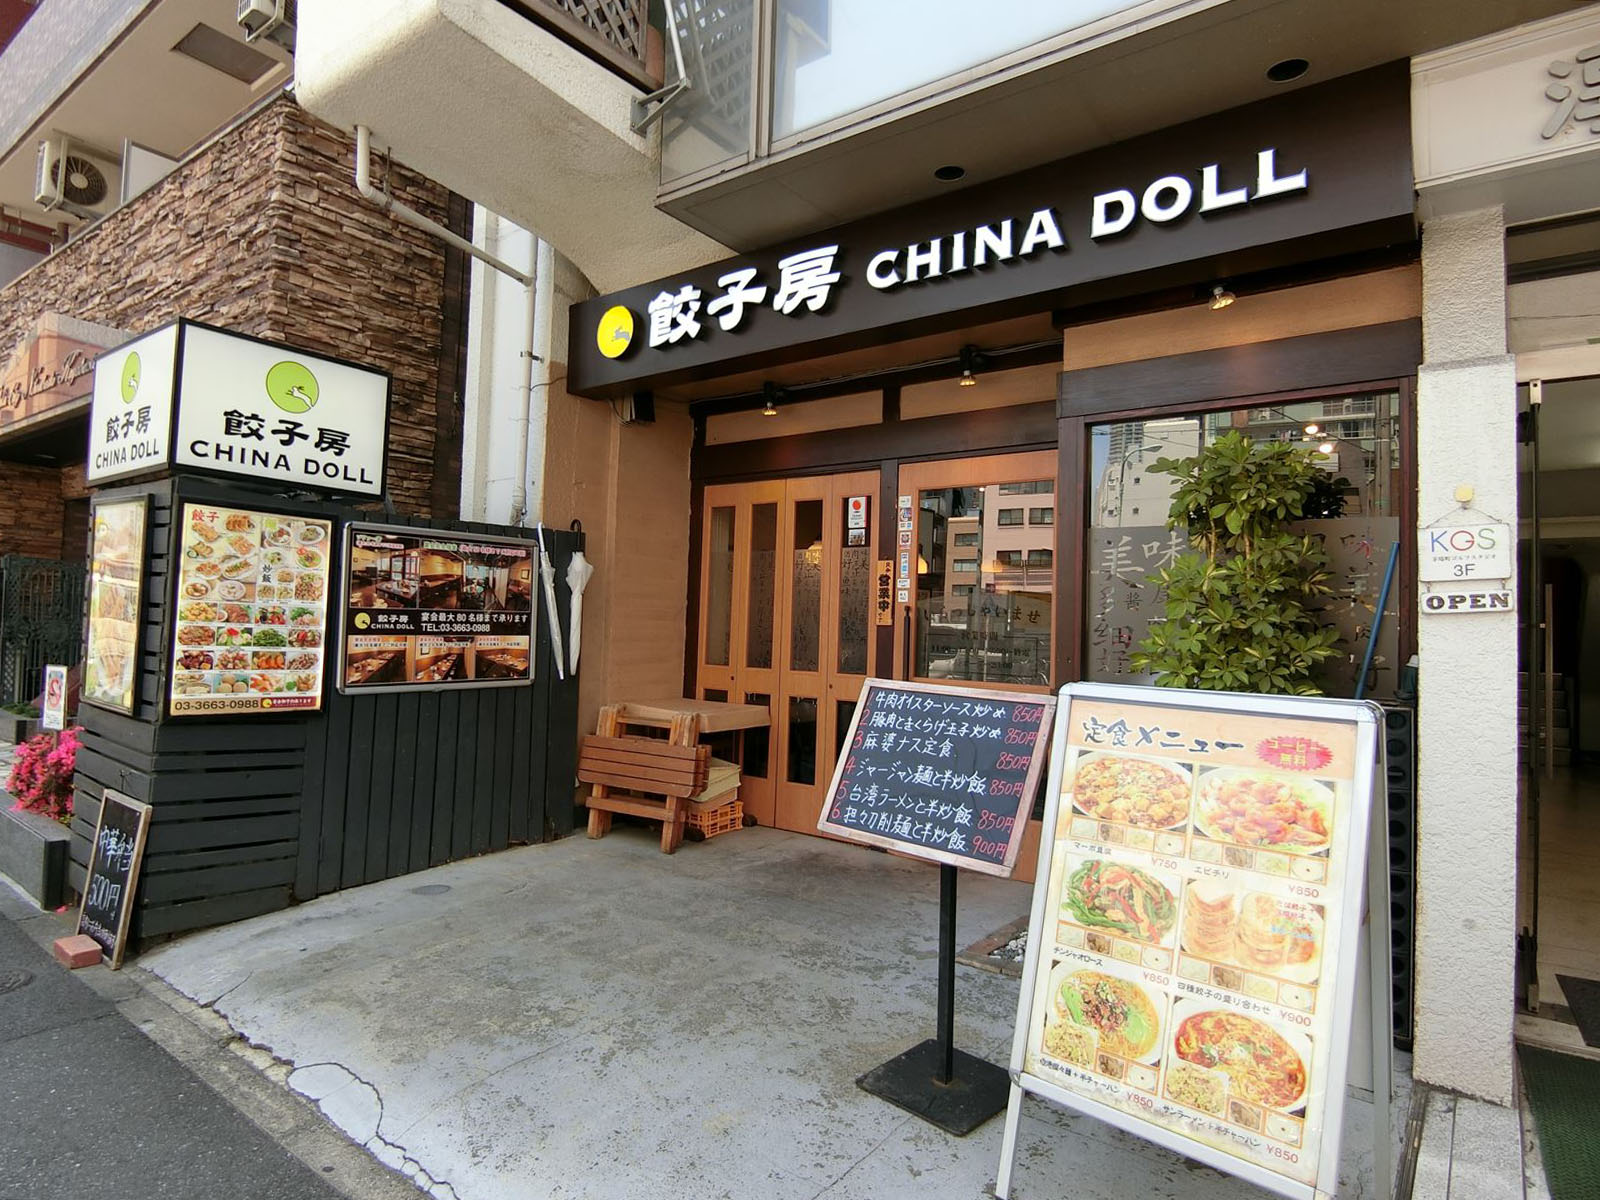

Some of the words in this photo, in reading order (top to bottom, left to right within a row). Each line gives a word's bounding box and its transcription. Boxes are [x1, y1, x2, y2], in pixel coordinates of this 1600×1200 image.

[648, 244, 841, 348] 餃子房
[866, 207, 1066, 291] CHINA
[1090, 147, 1308, 240] DOLL
[106, 405, 152, 444] 餃子房
[223, 409, 351, 457] 餃子房
[95, 447, 127, 469] CHINA
[130, 439, 160, 461] DOLL
[190, 440, 292, 471] CHINA
[303, 458, 374, 485] DOLL
[192, 508, 219, 522] 餃子
[1430, 528, 1496, 552] KGS
[1453, 563, 1476, 577] 3F
[879, 574, 891, 612] 営業中
[1426, 593, 1510, 610] OPEN
[378, 614, 409, 623] 餃子房
[174, 700, 259, 711] 03-3663-0988
[1012, 704, 1044, 723] 850円
[1004, 727, 1038, 746] 850円
[1082, 715, 1245, 754] 定食メニュー
[996, 751, 1032, 771] 850円
[989, 779, 1024, 797] 850円
[977, 809, 1015, 833] 850円
[972, 835, 1008, 860] 900円
[1193, 866, 1230, 879] エビチリ
[1287, 884, 1320, 898] ¥850
[1143, 970, 1170, 986] ¥850
[1279, 1009, 1312, 1027] ¥900
[1126, 1091, 1153, 1109] ¥850
[1265, 1143, 1299, 1164] ¥850
